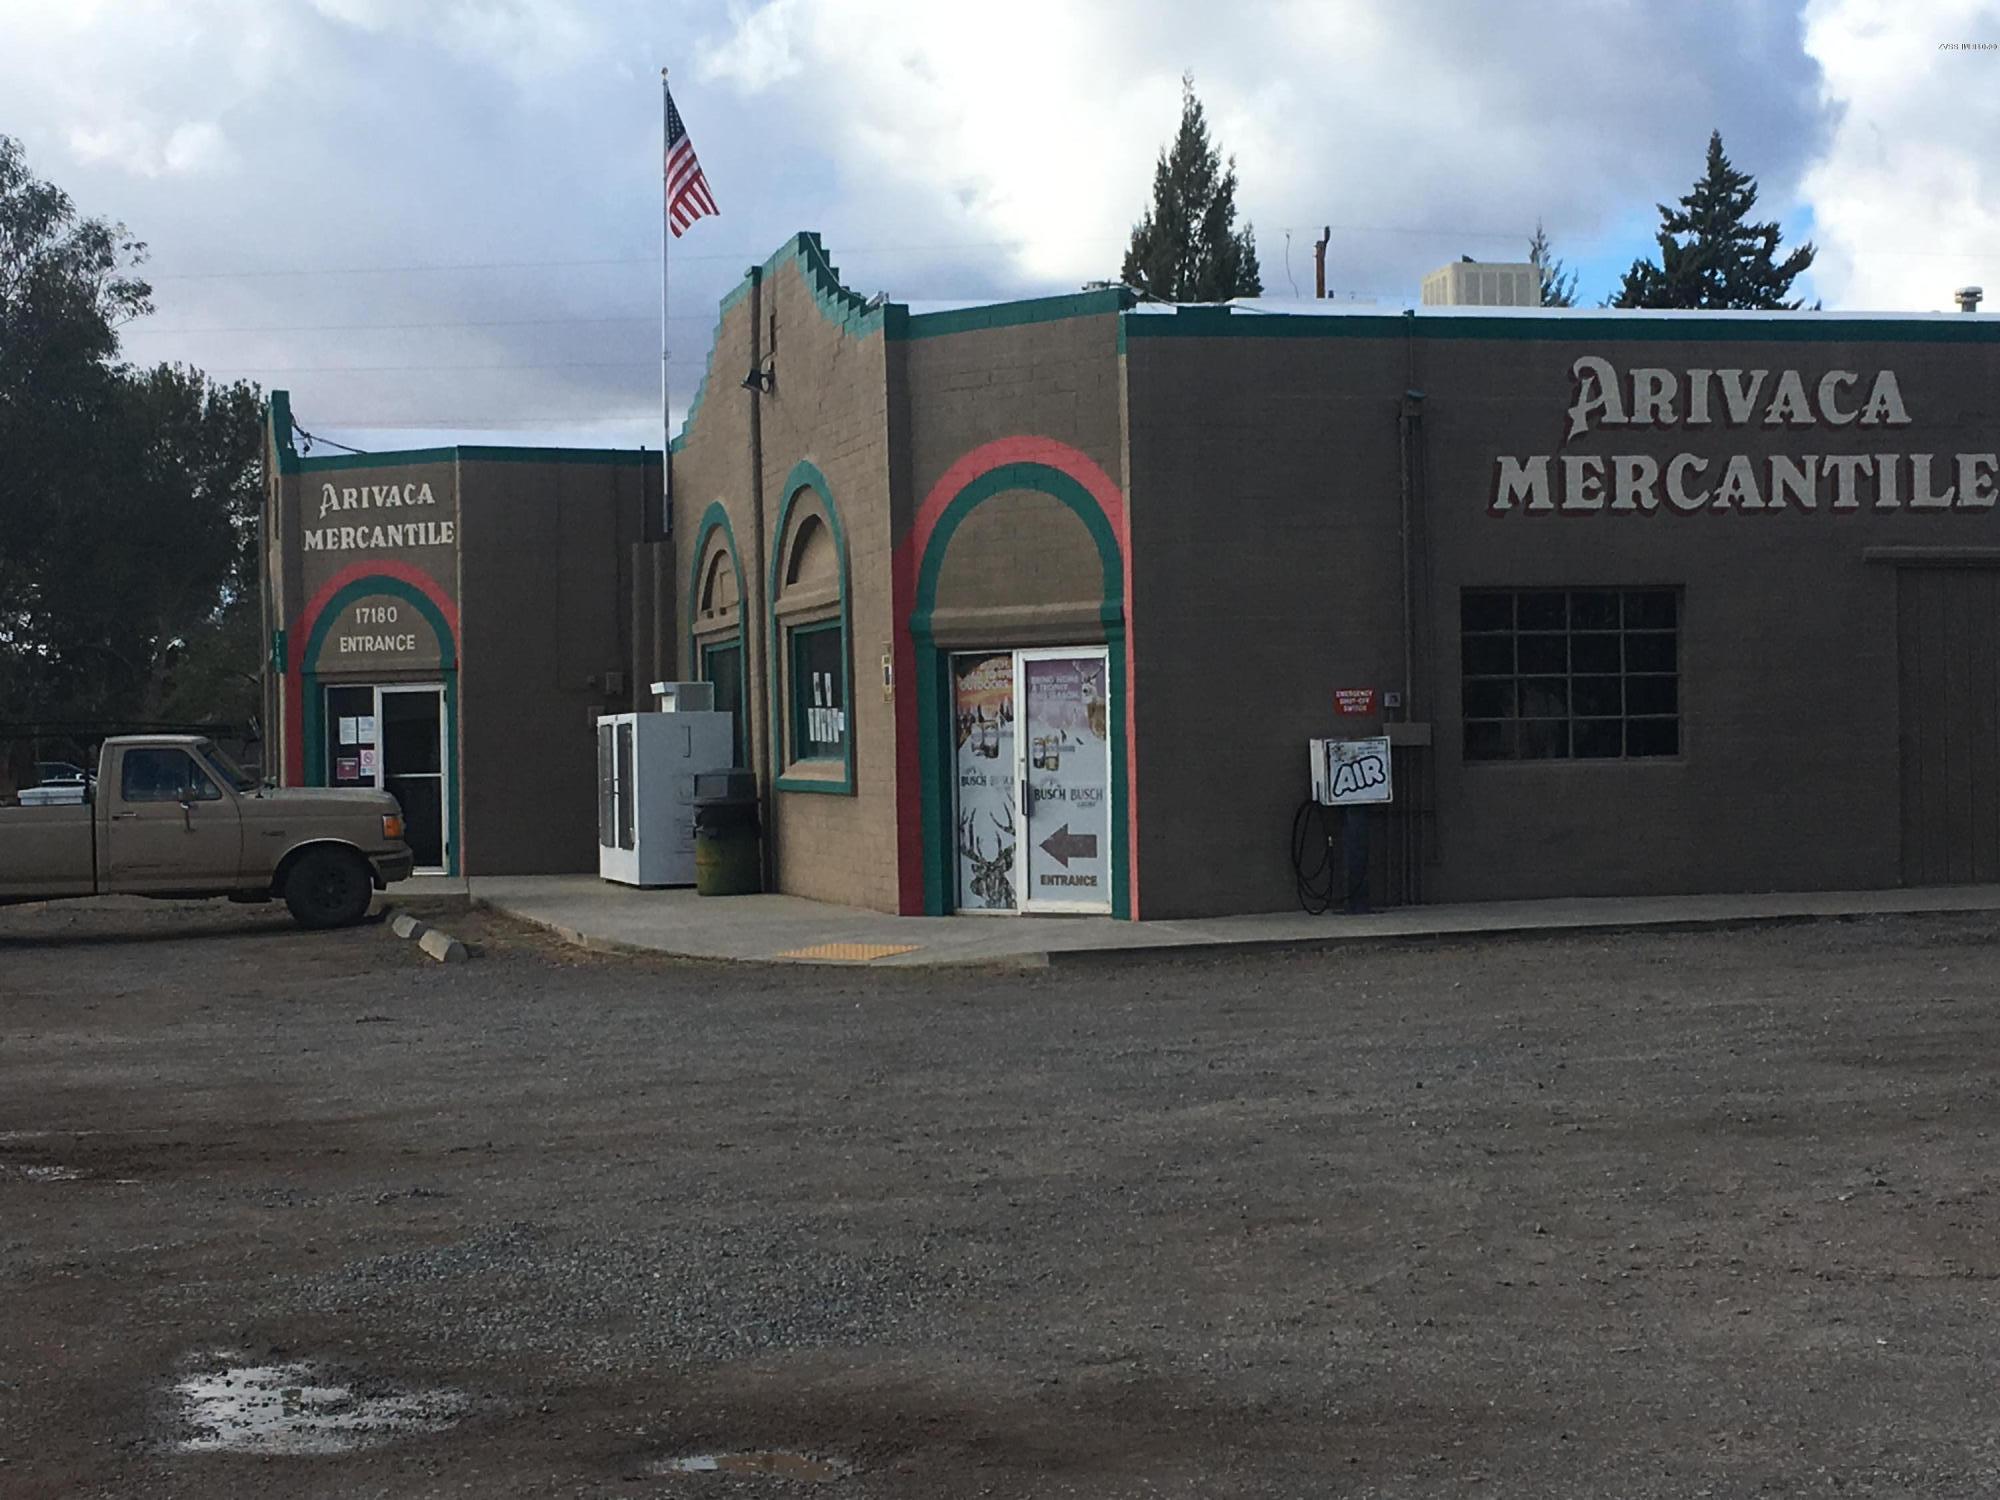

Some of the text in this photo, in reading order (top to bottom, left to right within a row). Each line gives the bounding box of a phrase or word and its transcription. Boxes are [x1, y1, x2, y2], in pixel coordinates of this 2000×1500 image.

[1567, 355, 1912, 442] ARIVACA
[1493, 453, 2000, 510] MERCANTILE
[319, 483, 436, 519] ARIVACA
[303, 521, 455, 551] MERCANTILE
[355, 606, 398, 624] 17180
[339, 634, 416, 653] ENTRANCE
[960, 775, 987, 787] BUSCH
[1333, 755, 1386, 797] AIR
[1034, 787, 1103, 801] BUSCH BUSCH
[1040, 874, 1097, 887] ENTRANCE
